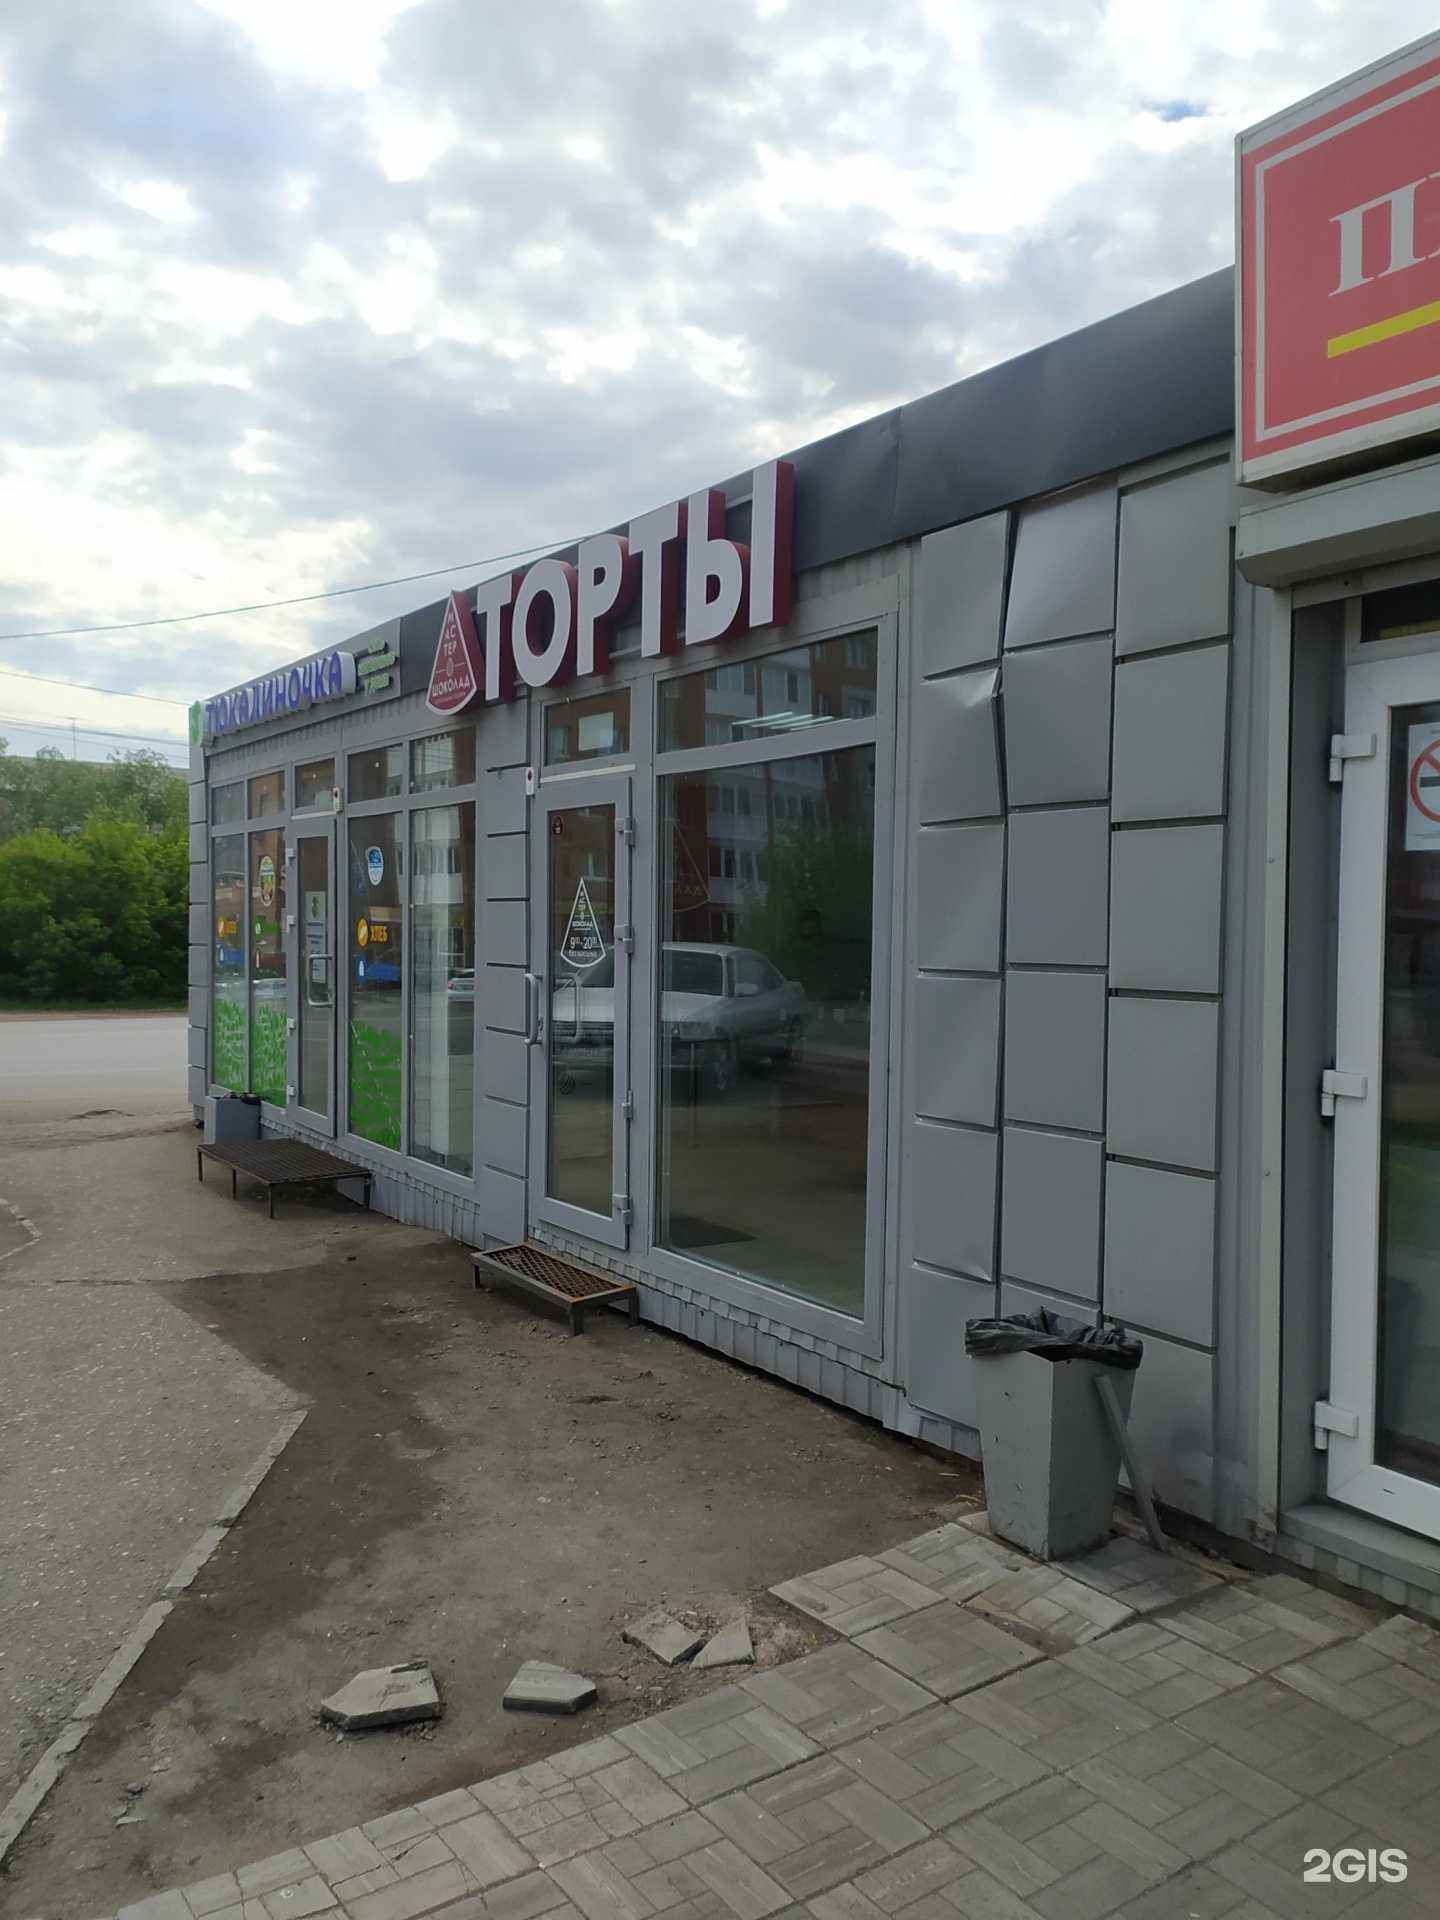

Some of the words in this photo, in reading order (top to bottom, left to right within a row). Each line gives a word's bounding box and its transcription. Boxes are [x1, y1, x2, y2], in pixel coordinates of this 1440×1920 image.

[1328, 170, 1440, 297] П
[476, 461, 778, 702] ТОРТЫ
[432, 677, 471, 697] ШОКОЛАД
